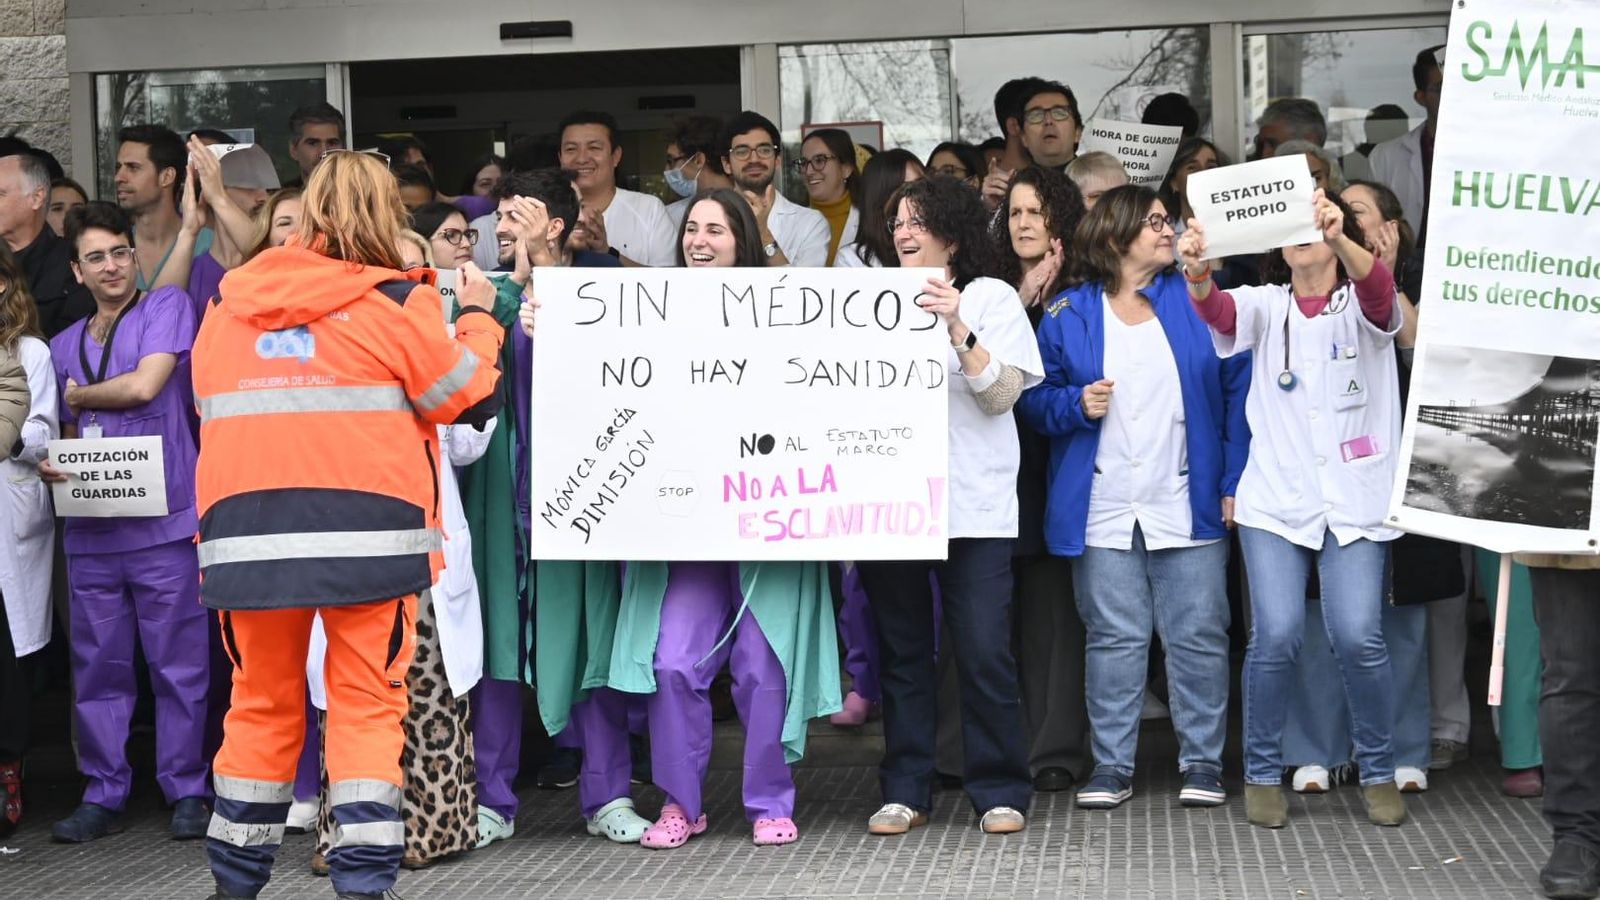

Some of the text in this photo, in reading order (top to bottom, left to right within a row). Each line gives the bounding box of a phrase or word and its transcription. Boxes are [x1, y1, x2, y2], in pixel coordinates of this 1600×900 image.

[1563, 105, 1600, 118] Huelva
[1092, 128, 1180, 145] HORA DE GUARDIA
[1118, 146, 1149, 158] IGUAL
[1122, 160, 1151, 171] HORA
[1210, 179, 1296, 204] ESTATUTO
[1226, 201, 1288, 222] PROPIO
[575, 274, 938, 331] SIN MÉDICOS
[1442, 280, 1600, 314] tus derechos
[291, 375, 304, 386] DE
[305, 375, 336, 386] SALUD
[602, 356, 944, 389] NO HAY SANIDAD
[740, 427, 913, 458] NO AL ESTATUTO
[837, 445, 898, 457] MARCO
[58, 448, 149, 464] COTIZACIÓN
[80, 469, 133, 481] DE LAS
[541, 408, 637, 529] MÓNICA GARCÍA
[570, 429, 655, 544] DIMISIÓN
[659, 486, 694, 497] STOP
[723, 464, 838, 502] NO A LA
[71, 487, 147, 499] GUARDIAS
[738, 477, 946, 541] ESCLAVITUD!
